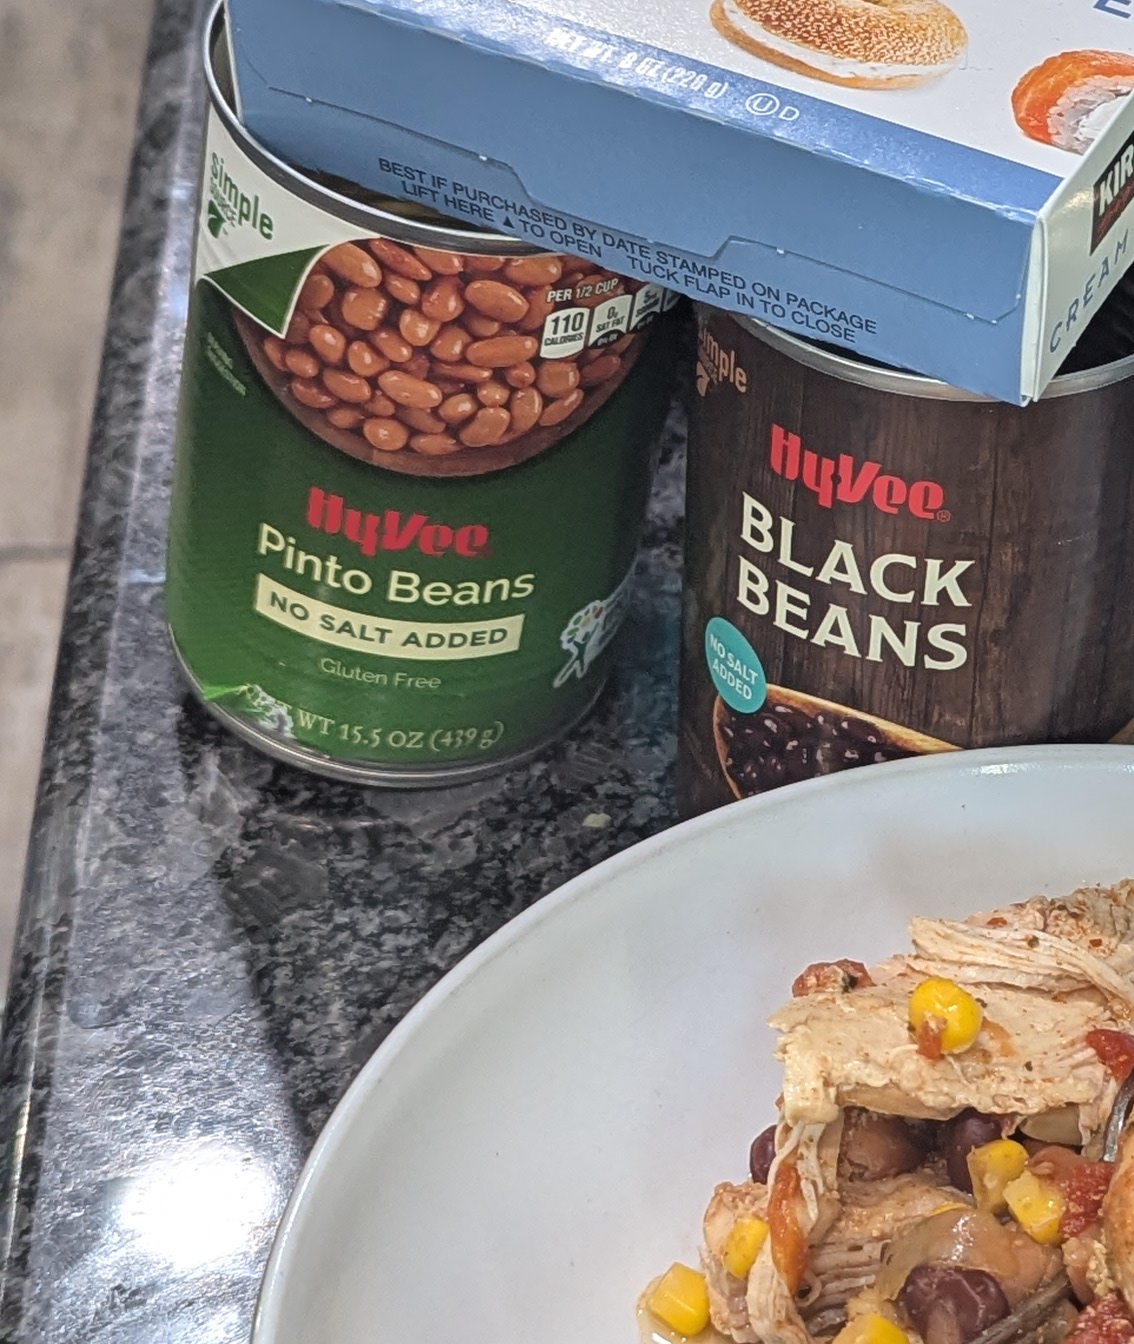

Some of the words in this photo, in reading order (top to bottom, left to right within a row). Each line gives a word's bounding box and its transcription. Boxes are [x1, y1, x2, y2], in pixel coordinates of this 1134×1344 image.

[544, 27, 586, 53] NET
[618, 53, 632, 69] 8
[379, 157, 426, 185] BEST
[432, 175, 448, 189] IF
[453, 181, 567, 231] PURCHASED
[572, 221, 600, 241] BY
[602, 232, 651, 260] DATE
[656, 250, 746, 290] STAMPED
[752, 282, 781, 301] ON
[786, 292, 877, 335] PACKAGE
[401, 180, 438, 202] LIFT
[444, 197, 495, 222] HERE
[518, 219, 545, 238] TO
[550, 231, 602, 258] OPEN
[547, 289, 572, 302] PER
[575, 286, 592, 299] 1/2
[595, 278, 619, 294] CUP
[626, 255, 680, 285] TUCK
[684, 275, 731, 300] FLAP
[736, 292, 754, 309] IN
[761, 300, 786, 319] TO
[791, 312, 856, 344] CLOSE
[1050, 229, 1130, 354] CREAM
[544, 333, 584, 346] CALORIES
[551, 312, 585, 336] 110
[258, 522, 373, 595] Pinto
[388, 570, 536, 606] Beans
[740, 491, 976, 608] BLACK
[270, 591, 310, 621] NO
[320, 614, 393, 644] SALT
[401, 628, 508, 649] ADDED
[736, 555, 969, 671] BEANS
[320, 658, 388, 686] Gluten
[394, 672, 442, 689] Free
[709, 633, 726, 659] NO
[727, 652, 758, 685] SALT
[712, 658, 753, 700] ADDED
[297, 708, 335, 735] WT
[340, 724, 382, 748] 15.5
[388, 730, 425, 749] OZ
[430, 728, 478, 752] (439
